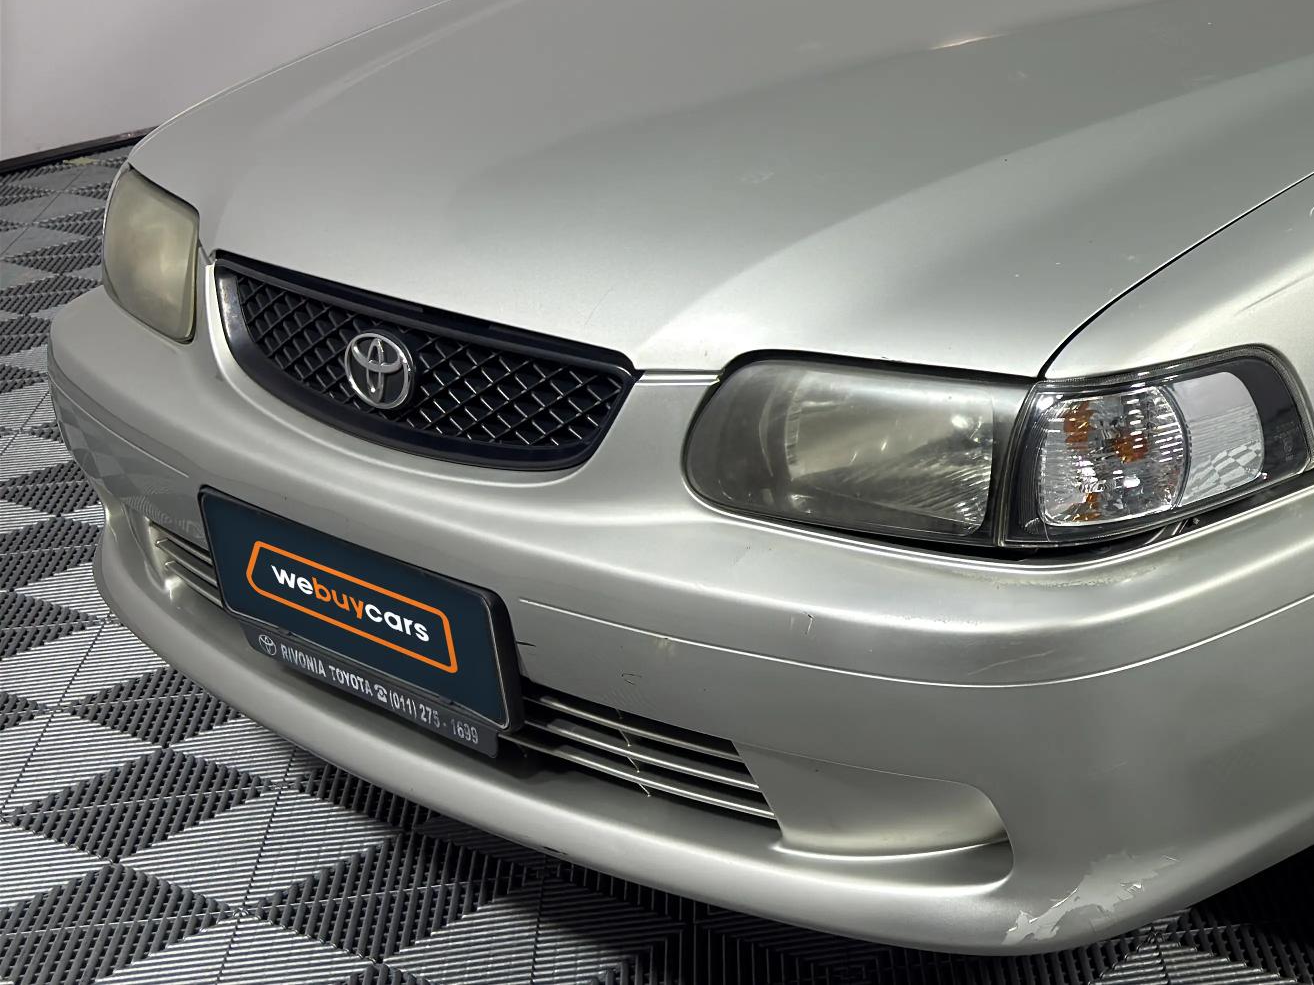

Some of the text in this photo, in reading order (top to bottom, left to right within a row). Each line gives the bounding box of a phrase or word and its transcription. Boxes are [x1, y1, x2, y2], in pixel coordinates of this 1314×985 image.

[271, 564, 430, 642] webuycars
[280, 643, 327, 678] RIVONIA
[328, 665, 374, 696] TOYOTA
[389, 689, 417, 720] (011)
